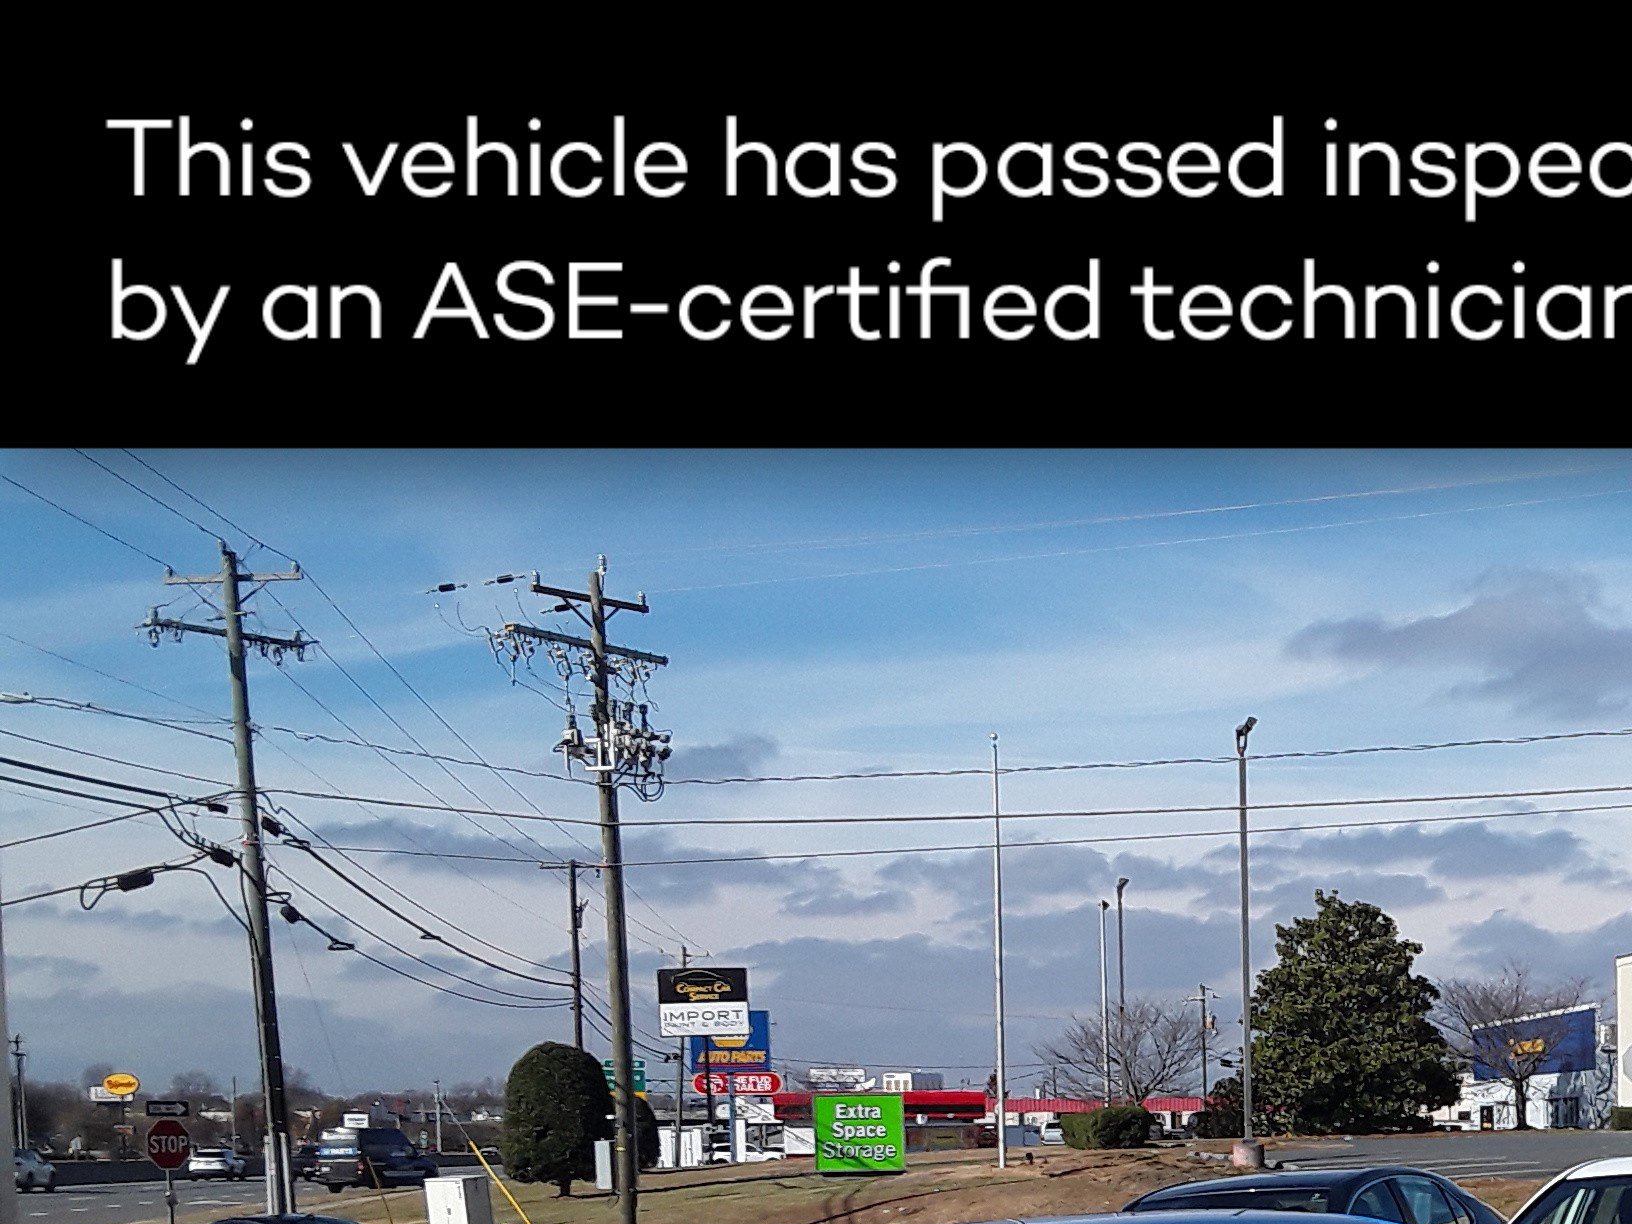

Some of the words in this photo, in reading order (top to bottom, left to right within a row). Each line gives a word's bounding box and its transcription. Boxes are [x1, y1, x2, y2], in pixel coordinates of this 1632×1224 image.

[663, 1010, 743, 1021] IMPORT
[835, 1103, 882, 1119] Extra
[832, 1121, 887, 1141] Space
[150, 1135, 188, 1153] STOP
[822, 1142, 897, 1161] Storage
